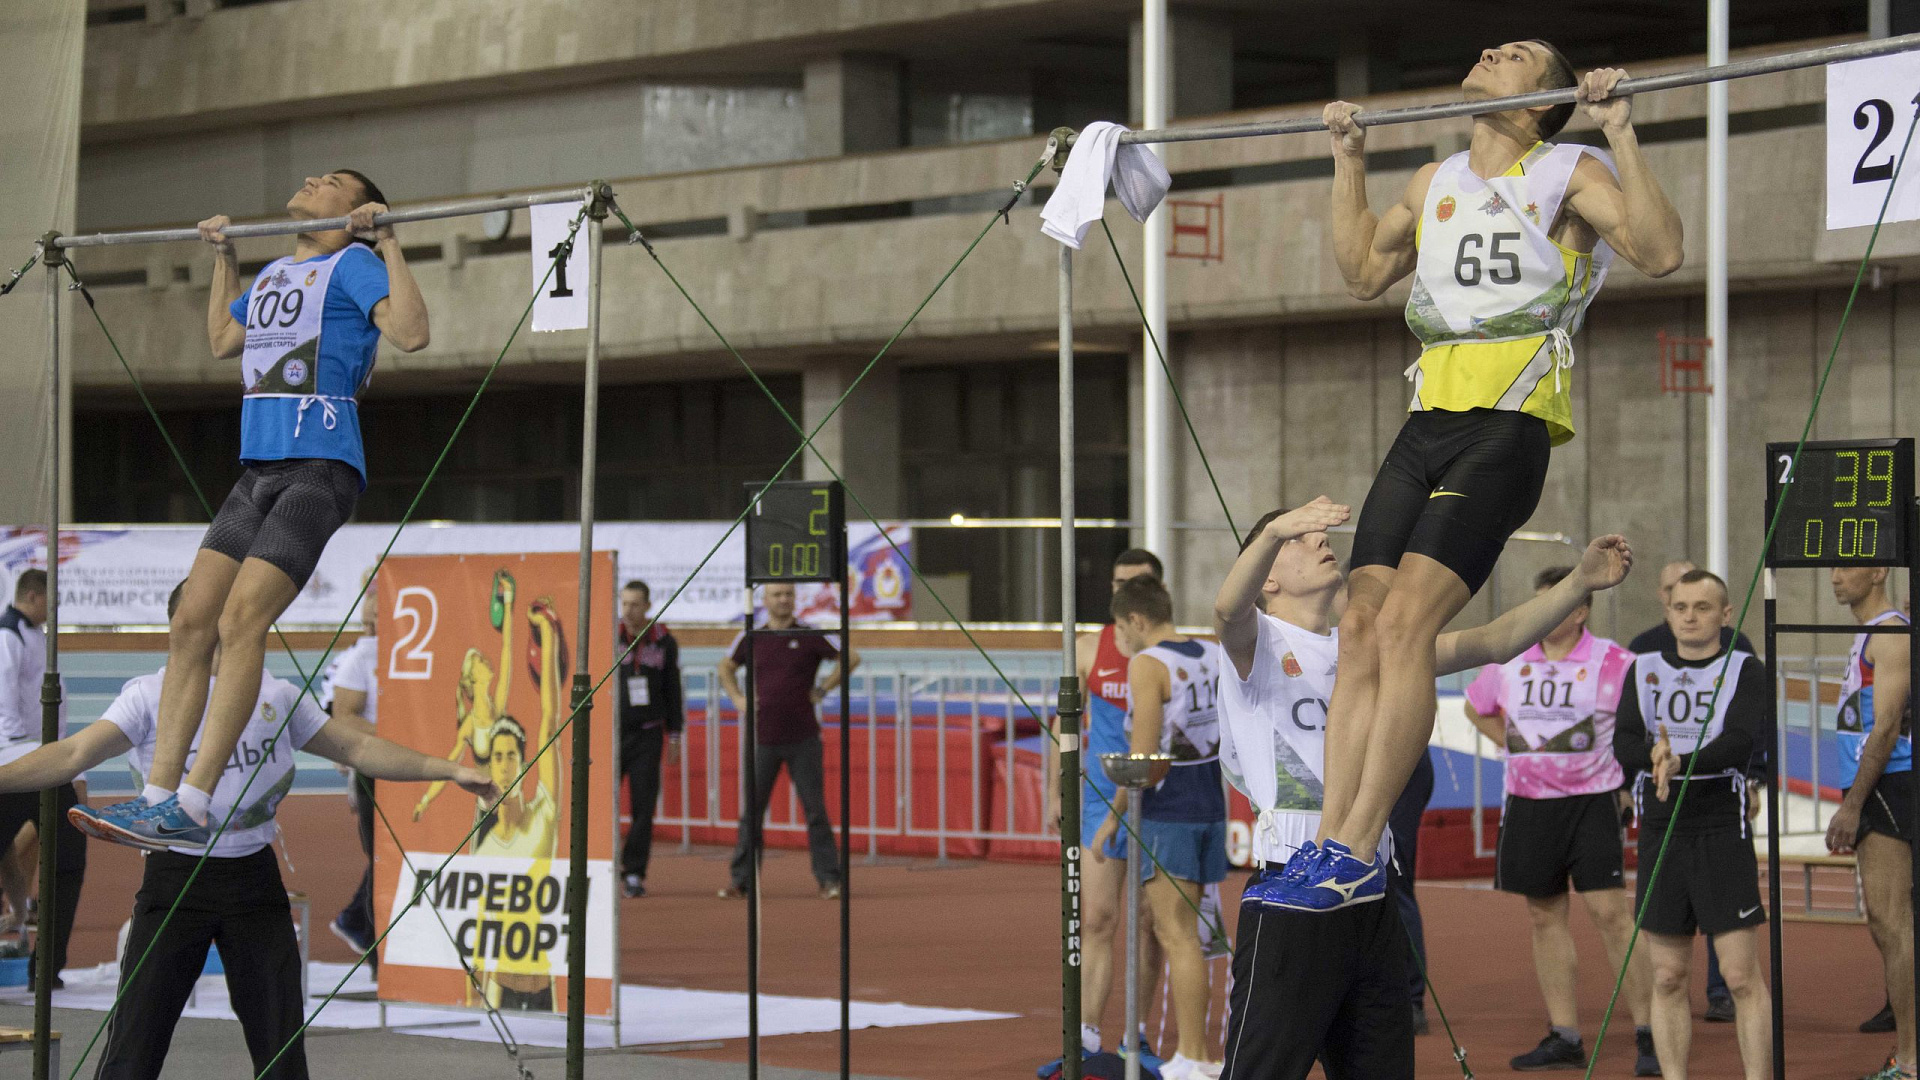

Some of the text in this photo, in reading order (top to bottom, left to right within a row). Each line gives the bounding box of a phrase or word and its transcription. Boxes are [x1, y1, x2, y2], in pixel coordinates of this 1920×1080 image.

[1853, 98, 1895, 184] 2
[548, 241, 574, 298] 1
[1454, 232, 1522, 287] 65
[246, 288, 304, 330] 109
[1778, 450, 1894, 507] 2 39
[809, 489, 829, 536] 2
[388, 586, 439, 680] 2
[1521, 680, 1576, 708] 101
[1652, 690, 1715, 724] 105
[183, 738, 277, 776] СДЬЯ
